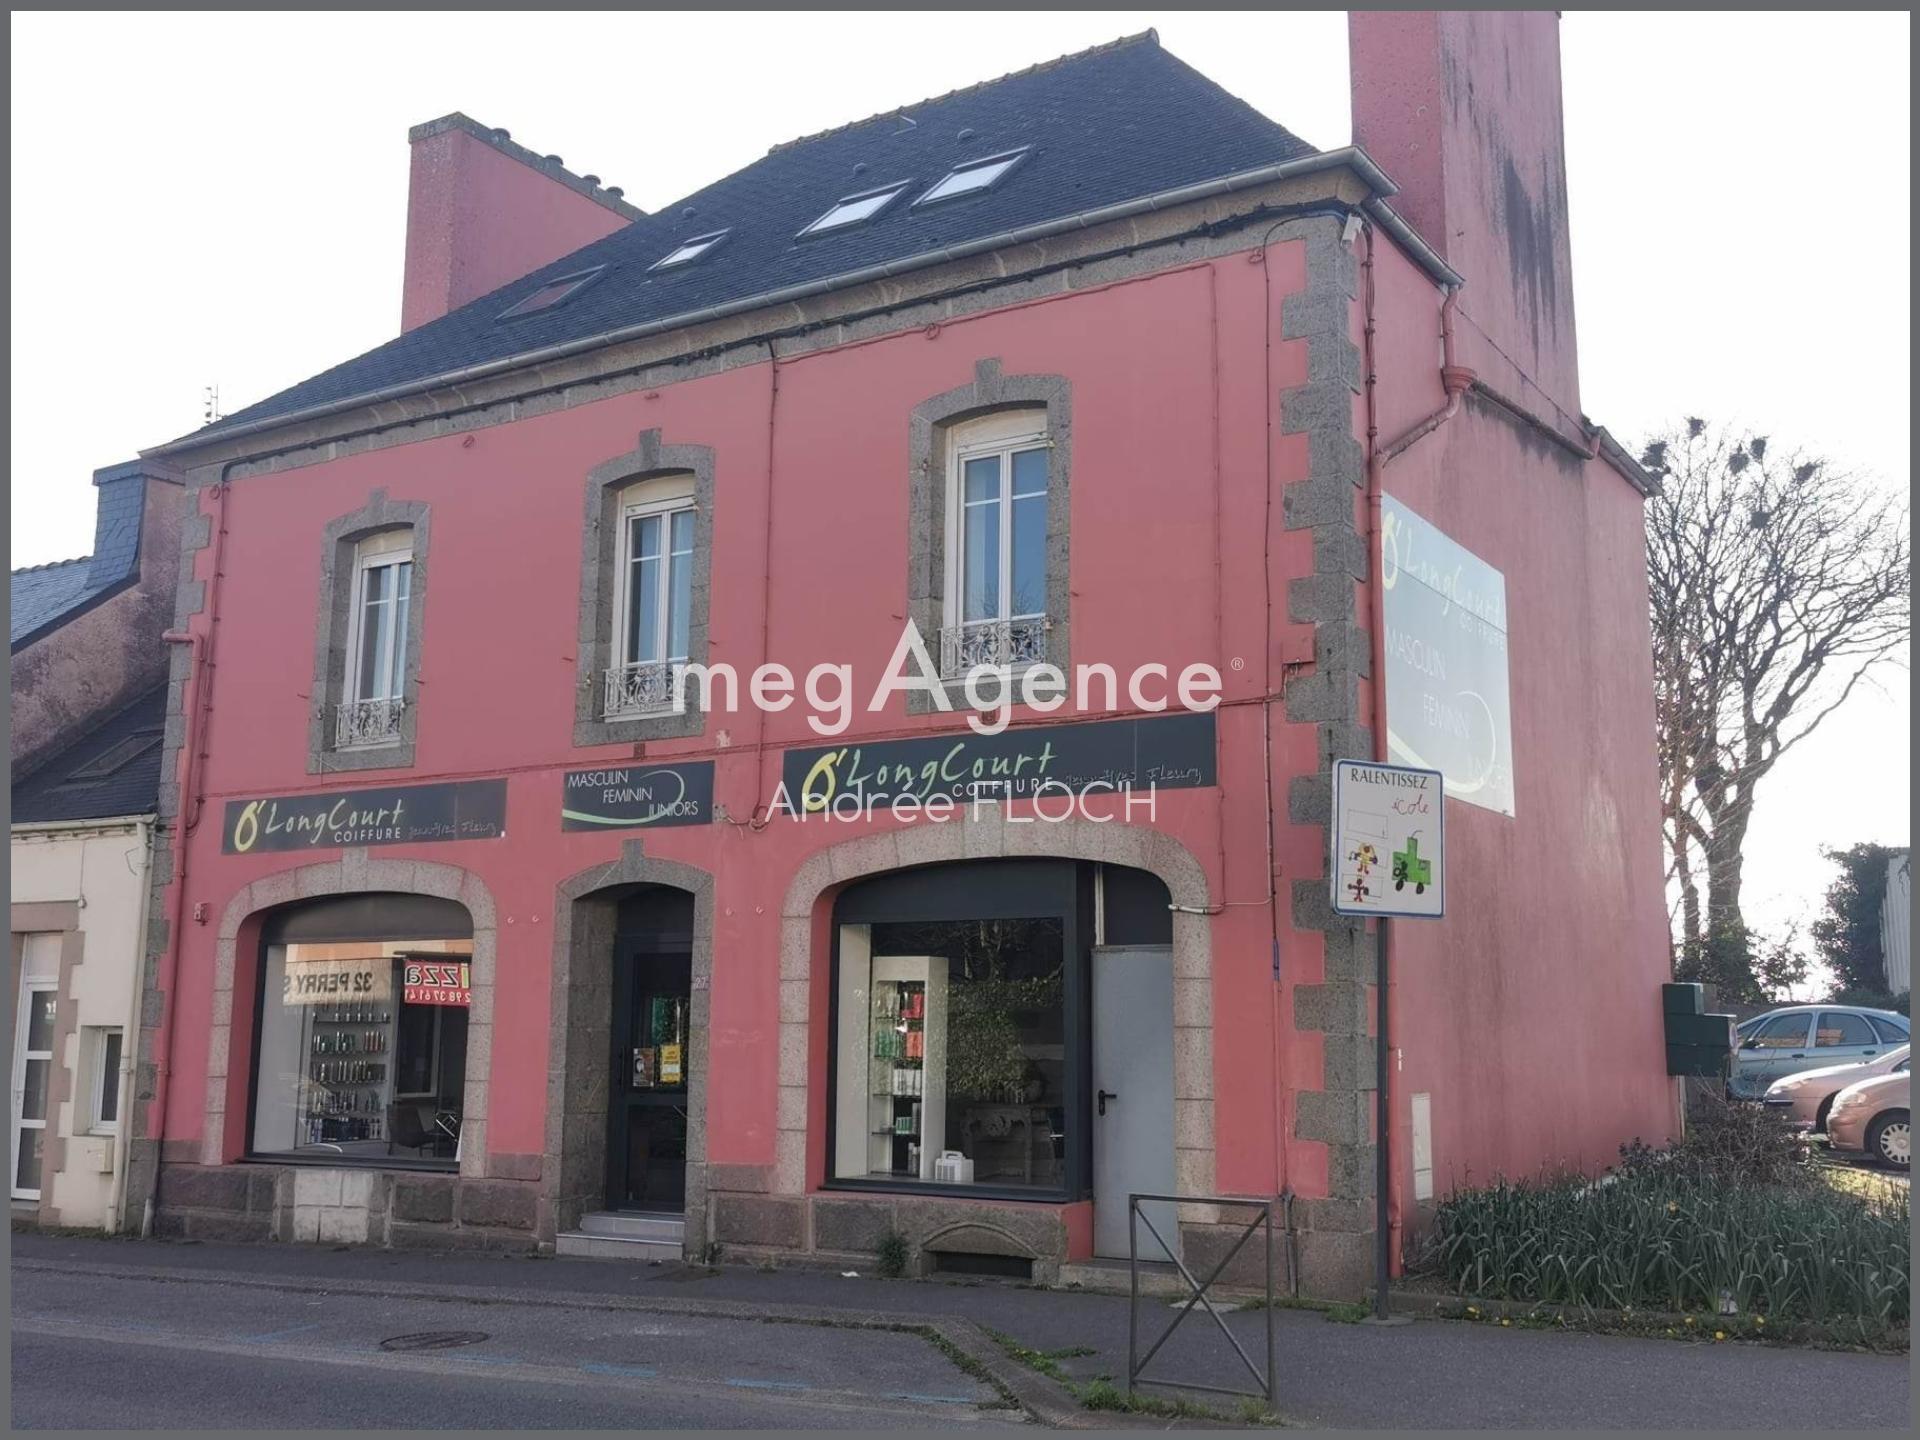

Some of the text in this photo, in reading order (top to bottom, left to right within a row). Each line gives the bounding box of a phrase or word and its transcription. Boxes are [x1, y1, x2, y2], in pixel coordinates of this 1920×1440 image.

[567, 770, 629, 788] MASCULIN
[952, 776, 1054, 797] COIFFURE
[1351, 768, 1428, 789] RALENTISSEZ
[602, 787, 654, 803] FEMININ
[648, 801, 698, 818] JUNIORS
[334, 827, 401, 843] COIFFURE
